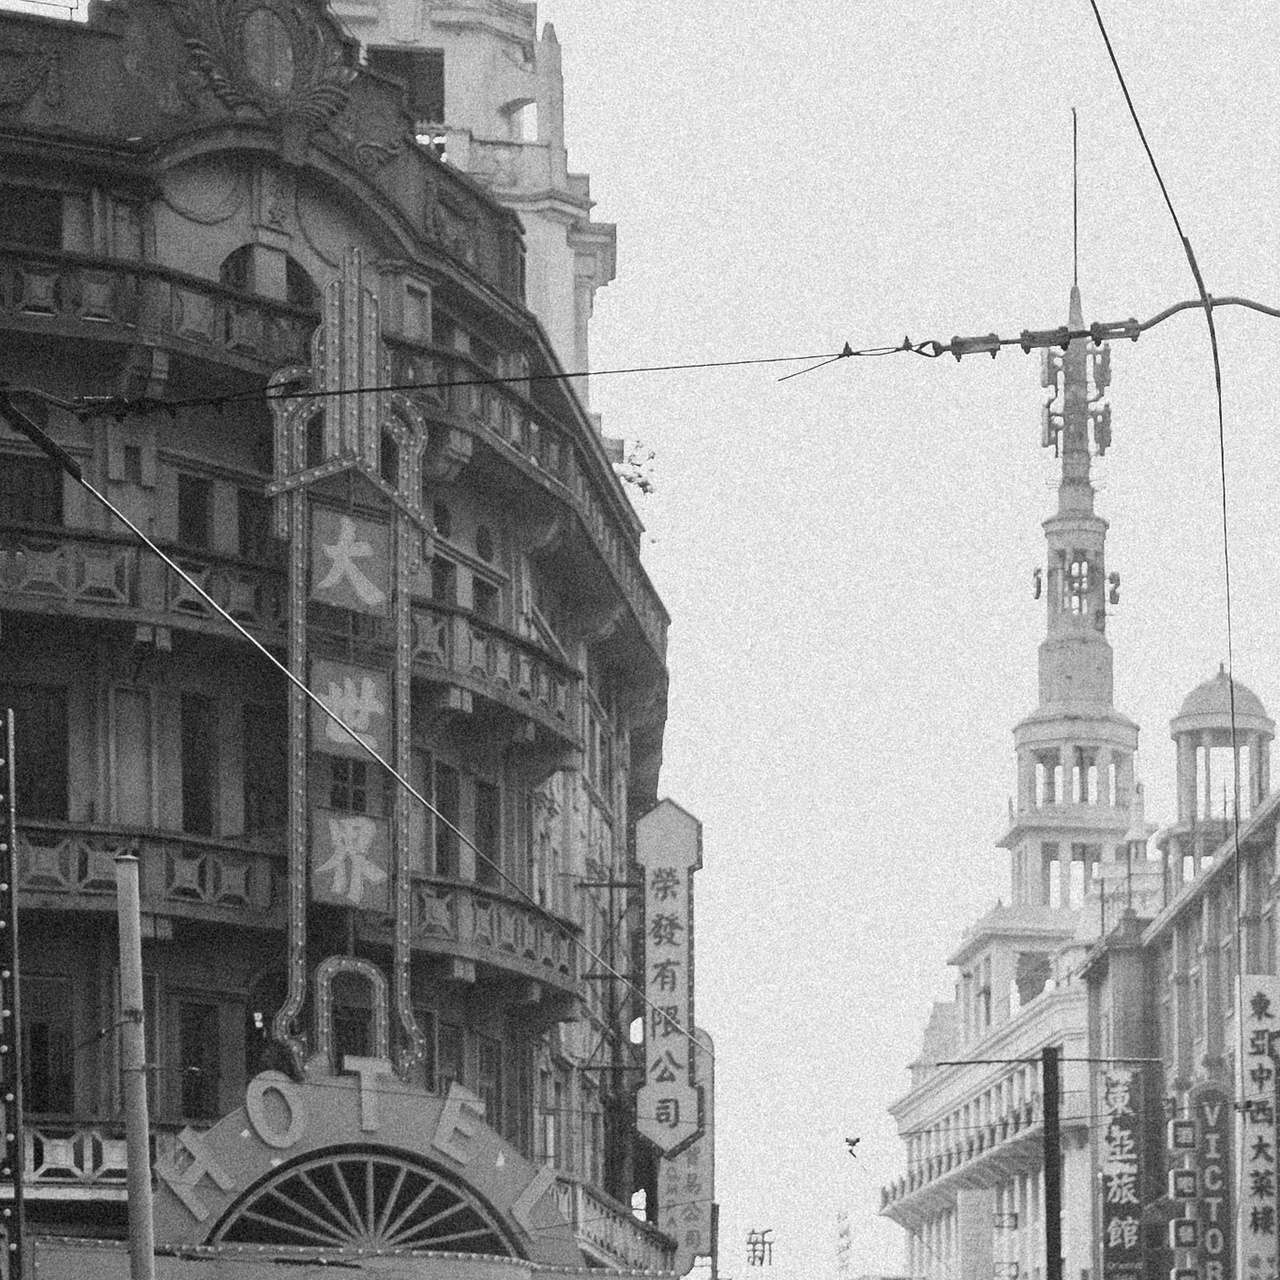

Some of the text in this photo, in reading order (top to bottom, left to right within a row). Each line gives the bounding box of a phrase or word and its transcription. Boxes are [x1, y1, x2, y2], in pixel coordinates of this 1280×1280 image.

[314, 516, 387, 906] 大世界
[649, 866, 685, 1130] 榮發有限公司
[154, 1055, 557, 1226] HOTEL
